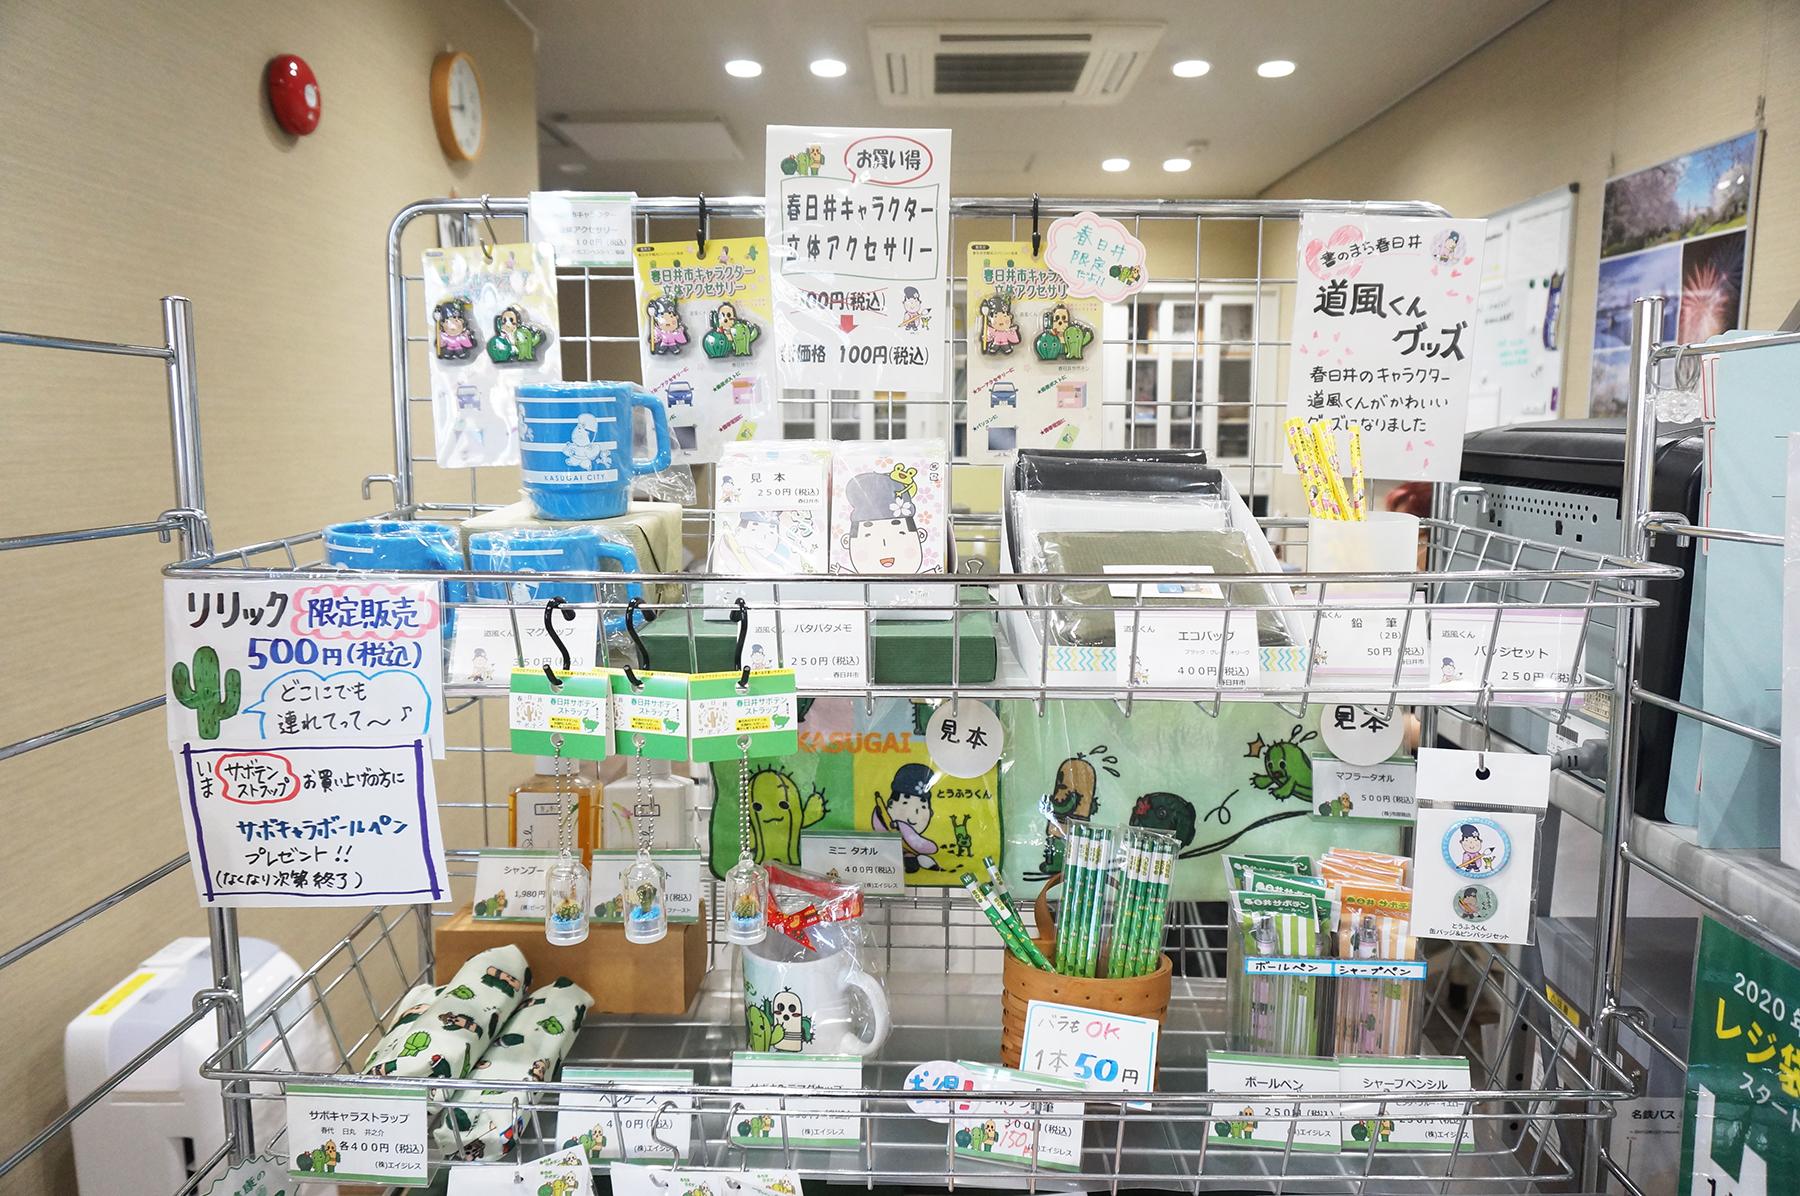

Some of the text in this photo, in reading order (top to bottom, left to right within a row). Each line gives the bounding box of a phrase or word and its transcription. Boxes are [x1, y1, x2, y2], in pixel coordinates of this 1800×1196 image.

[857, 149, 921, 170] お買い得
[786, 193, 934, 221] 春日井キャラクター
[787, 234, 933, 262] 立体アクセサリー
[1073, 225, 1126, 262] 春日井
[1070, 249, 1106, 271] 限定
[650, 264, 755, 288] 春日井市キャラクター
[983, 268, 1068, 285] 春日井市キャラ
[800, 291, 886, 311] 00円(税込)
[1313, 278, 1428, 319] 道風くん
[1392, 320, 1468, 361] グッズ
[839, 345, 929, 366] 100円(税込)
[1309, 366, 1450, 385] 春日井のキャラクター
[1307, 389, 1449, 411] 道風くんがかわいい
[1308, 413, 1427, 432] グズになりました
[188, 591, 420, 630] リリック 限定販売
[525, 627, 575, 637] マグップ
[248, 637, 423, 670] 500円(税込)
[513, 657, 584, 668] 350円(込)
[1178, 666, 1250, 677] 400円税込)
[281, 680, 367, 702] どこにでも
[797, 731, 913, 754] KASUGAI
[940, 719, 988, 750] 見本
[196, 761, 215, 799] いま
[224, 759, 280, 785] サボテン
[302, 768, 405, 793] お買い上げの方に
[1336, 771, 1396, 783] マフラータオル
[236, 778, 291, 799] ストラップ
[936, 788, 993, 800] とうふうくん
[236, 814, 409, 843] サボキャラボールペン
[844, 865, 896, 876] 400円(税込)
[1452, 922, 1488, 932] とうふうくん
[1255, 961, 1319, 972] ボールペン
[1338, 965, 1412, 977] シャープペン
[1245, 1075, 1304, 1091] ボールペン
[1363, 1078, 1449, 1091] シャープペンシル
[309, 1110, 410, 1125] サボキャラストラップ
[1631, 1109, 1676, 1120] 名鉄バス
[607, 1119, 673, 1130] 40円(込)
[1286, 1128, 1332, 1138] ()エイジレス
[1424, 1130, 1470, 1139] (株)エイジス
[339, 1140, 426, 1156] 各400円(税込)
[633, 1144, 678, 1153] (株)エイジ
[1027, 1144, 1073, 1157] ()エイジレス
[375, 1160, 422, 1171] (株)エイジレス
